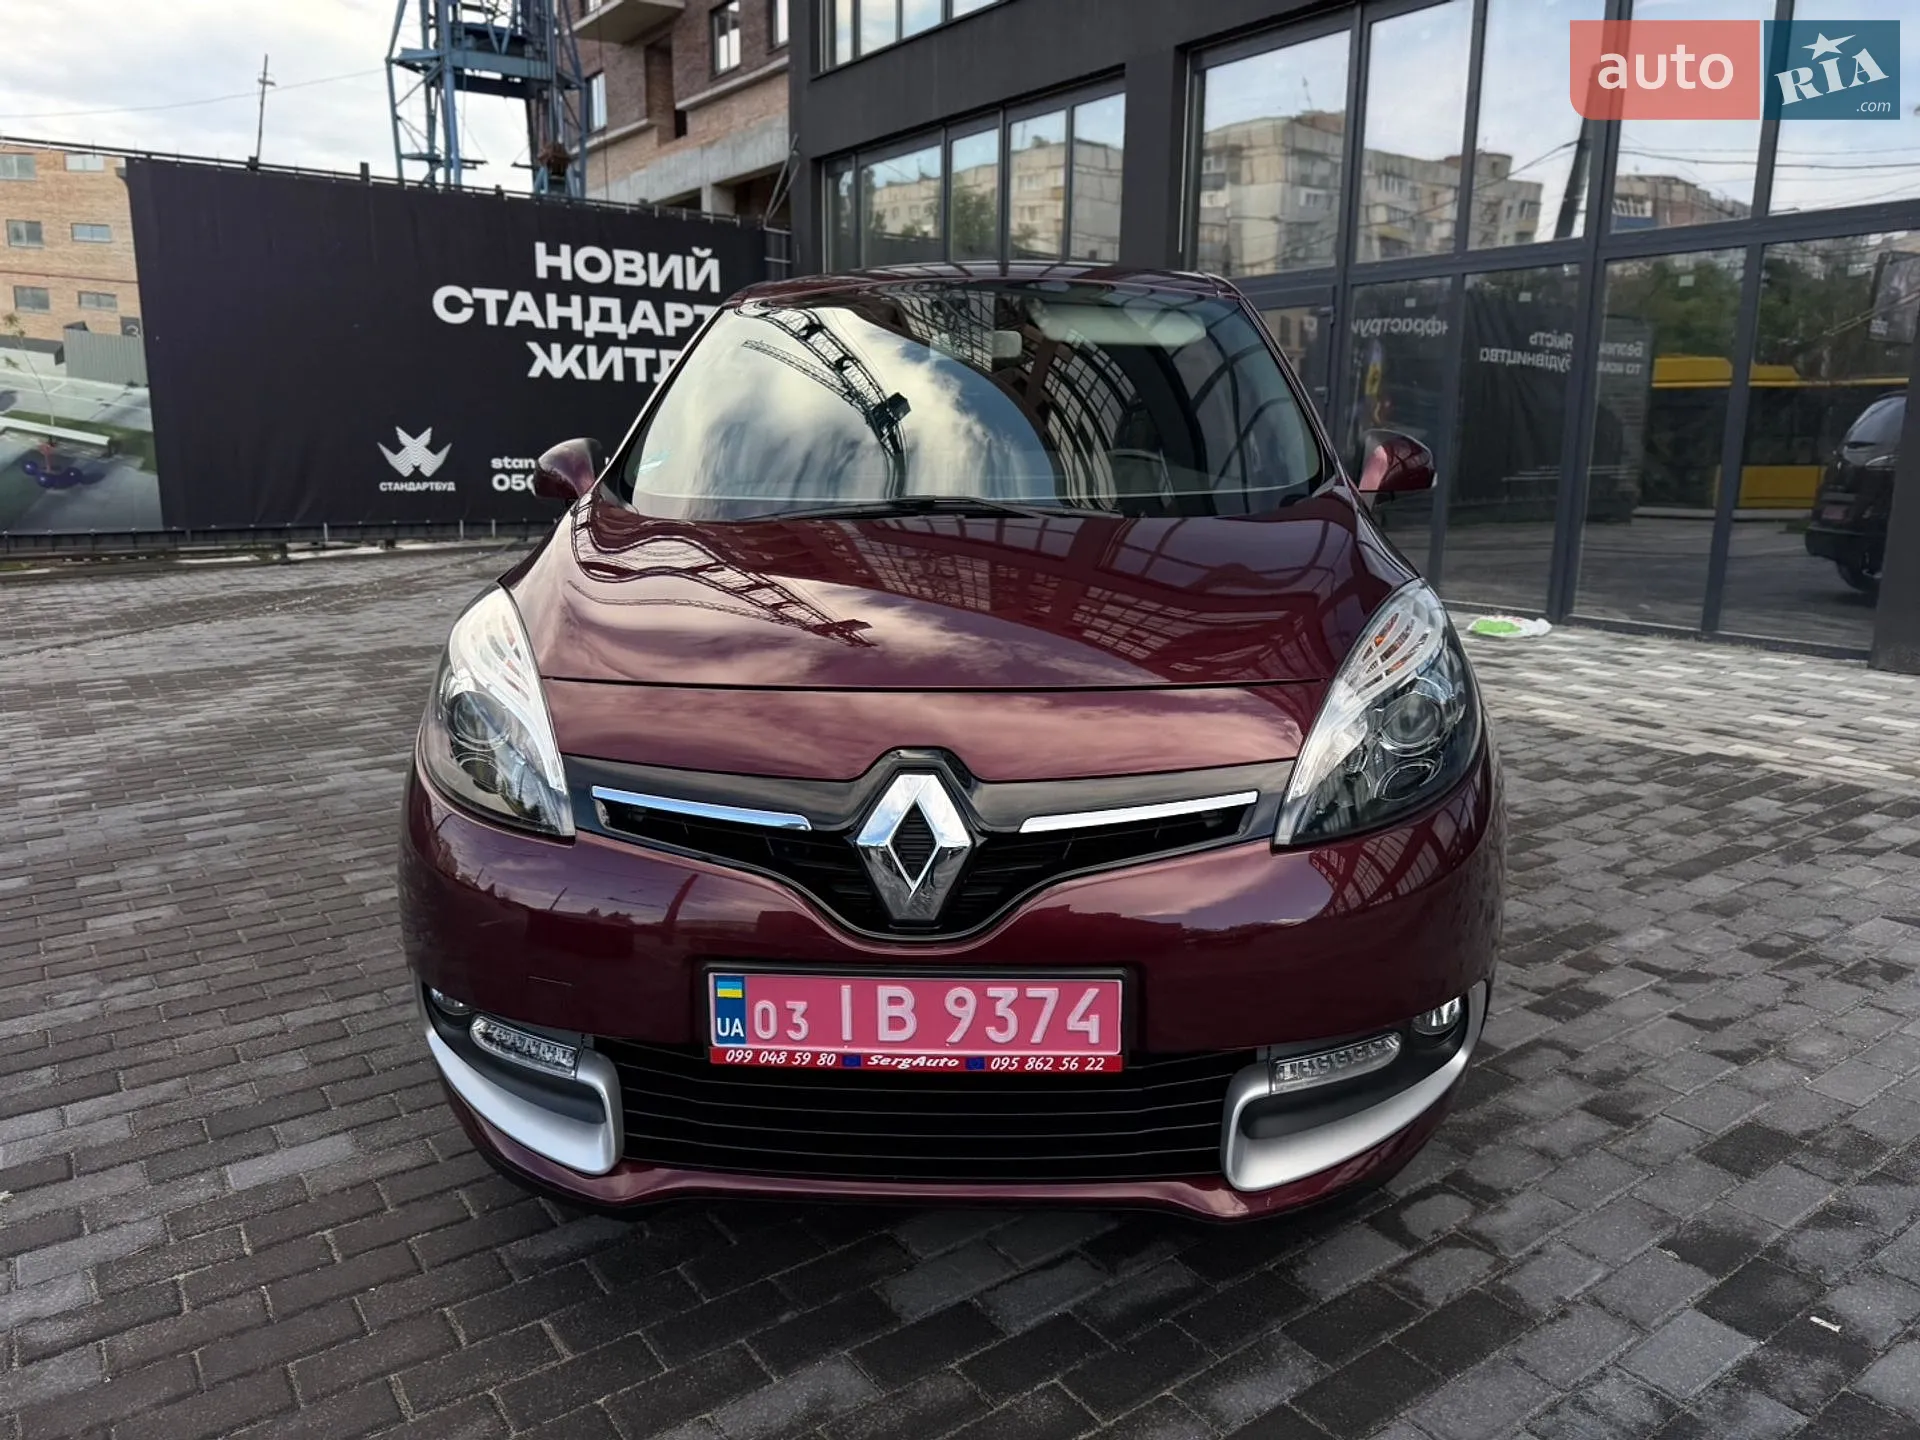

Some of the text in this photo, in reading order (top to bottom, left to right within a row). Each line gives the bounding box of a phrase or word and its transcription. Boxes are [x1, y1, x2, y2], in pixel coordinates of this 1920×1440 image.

[534, 241, 721, 293] НОВИЙ
[379, 481, 456, 492] СТАНДАРТБУД
[717, 1018, 744, 1038] UA
[753, 1000, 809, 1041] 03
[944, 986, 1100, 1045] 9374
[725, 1050, 836, 1066] 099 048 59 80
[868, 1054, 960, 1069] SergAuto
[991, 1057, 1105, 1071] 095 862 56 22
